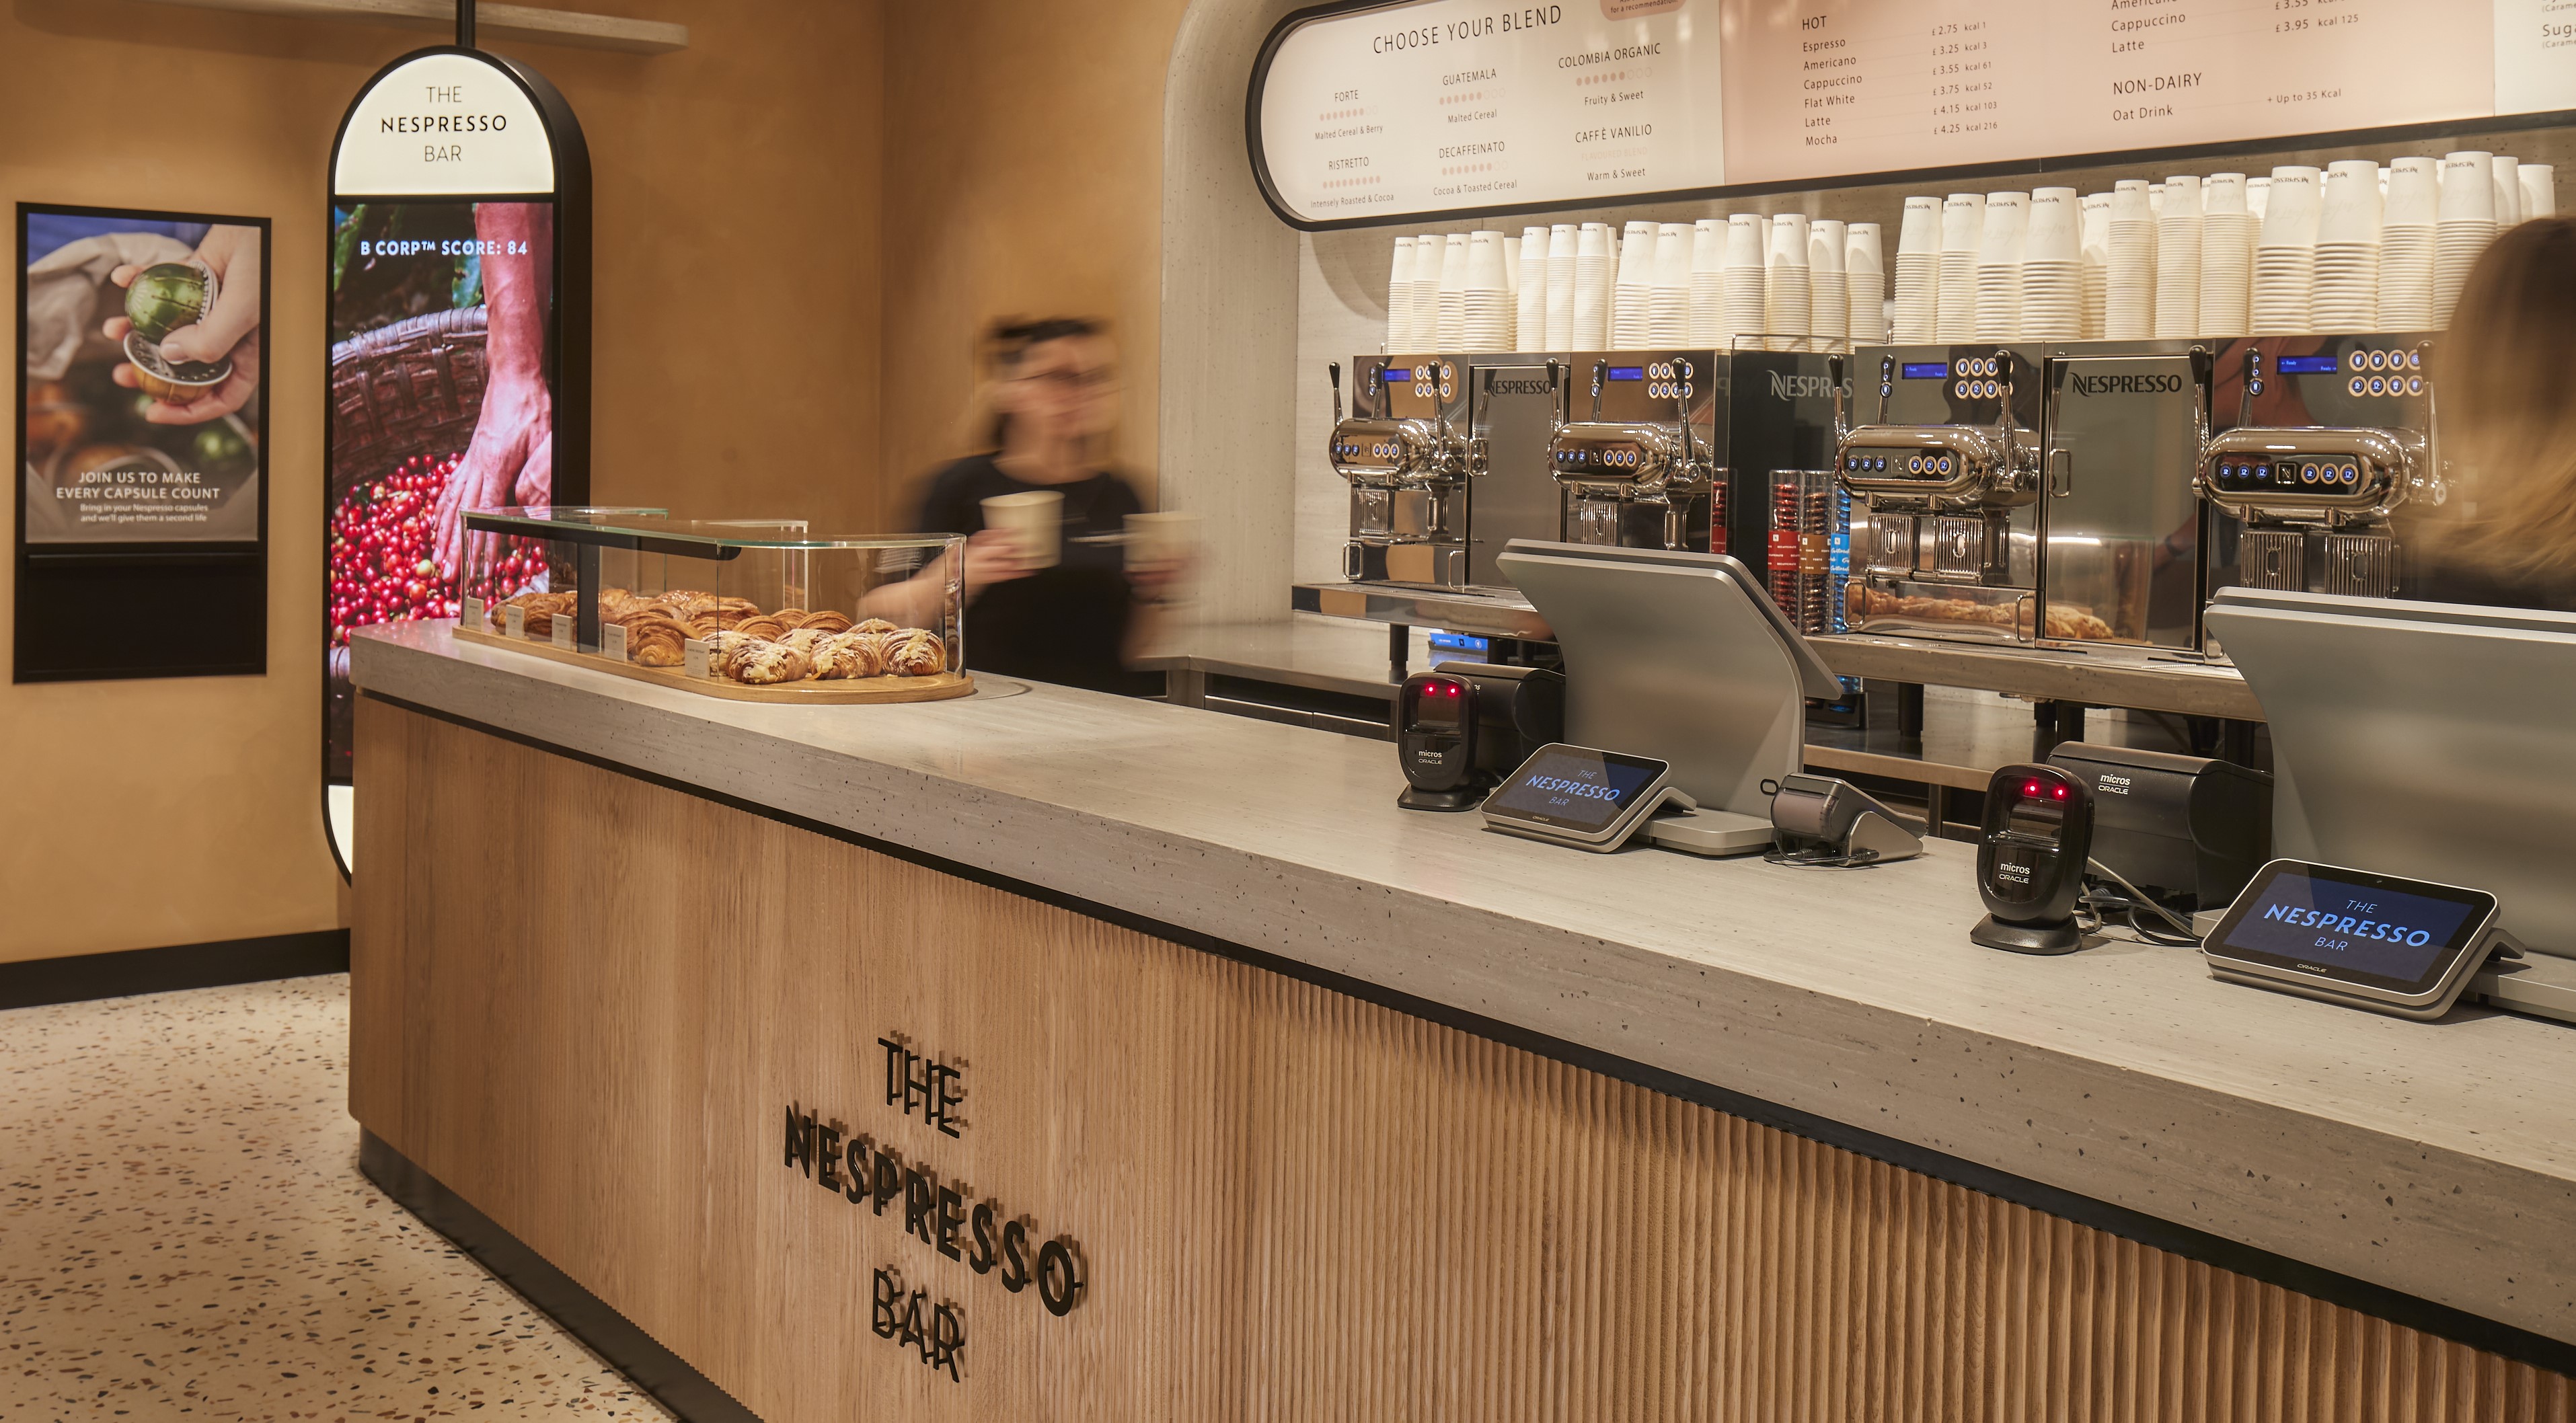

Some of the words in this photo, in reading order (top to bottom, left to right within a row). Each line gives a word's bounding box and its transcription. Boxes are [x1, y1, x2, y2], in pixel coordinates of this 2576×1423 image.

[1373, 26, 1439, 54] CHOOSE
[1447, 17, 1494, 41] YOUR
[1503, 5, 1562, 32] BLEND
[1802, 15, 1827, 31] HOT
[1938, 24, 1958, 36] 2.75
[1964, 23, 1979, 32] kcal
[2112, 13, 2186, 32] Cappuccino
[2284, 19, 2308, 32] 3.95
[2318, 16, 2337, 27] kcal
[2342, 14, 2359, 24] 125
[2542, 24, 2576, 38] Sug
[1803, 38, 1846, 53] Espresso
[1940, 44, 1959, 55] 3.25
[1965, 42, 1980, 52] kcal
[2112, 40, 2145, 53] Latte
[1558, 51, 1610, 69] COLOMBIA
[1614, 43, 1661, 61] ORGANIC
[1804, 56, 1856, 71] Americano
[1940, 64, 1959, 75] 3.55
[1965, 63, 1981, 72] kcal
[1983, 62, 1992, 70] 61
[1443, 69, 1497, 85] GUATEMALA
[1804, 75, 1862, 91] Cappuccino
[2114, 73, 2202, 95] NON-DAIRY
[425, 86, 462, 103] THE
[1334, 90, 1359, 102] FORTE
[1940, 85, 1959, 95] 3.75
[1965, 83, 1981, 92] kcal
[1984, 82, 1993, 91] 52
[1585, 95, 1608, 106] Fruity
[1610, 93, 1616, 102] &
[1619, 91, 1644, 102] Sweet
[1805, 98, 1823, 109] Flat
[1826, 95, 1855, 106] White
[2277, 95, 2289, 104] Up
[2294, 93, 2302, 102] to
[2306, 91, 2318, 100] 35
[2322, 89, 2341, 99] Kcal
[1940, 104, 1960, 115] 4.15
[1966, 102, 1981, 112] kcal
[1984, 102, 1997, 110] 103
[2113, 110, 2134, 121] Oat
[2139, 105, 2173, 119] Drink
[1447, 112, 1472, 124] Malted
[1474, 109, 1497, 120] Cereal
[1805, 116, 1831, 128] Latte
[381, 116, 506, 133] NESPRESSO
[1941, 124, 1961, 134] 4.25
[1967, 123, 1982, 132] kcal
[1984, 122, 1998, 130] 216
[1315, 130, 1336, 141] Malted
[1338, 128, 1358, 138] Cereal
[1360, 126, 1365, 134] &
[1367, 124, 1384, 135] Berry
[1575, 127, 1607, 143] CAFFÈ
[1610, 124, 1653, 140] VANILIO
[1806, 134, 1838, 146] Mocha
[424, 145, 461, 162] BAR
[1439, 141, 1505, 159] DECAFFEINATO
[1582, 148, 1622, 162] FLAVOURED
[1624, 147, 1648, 157] BLEND
[1329, 157, 1369, 170] RISTRETTO
[1587, 171, 1610, 182] Warm
[1613, 169, 1618, 179] &
[1620, 168, 1646, 179] Sweet
[1433, 186, 1455, 196] Cocoa
[1457, 186, 1462, 194] &
[1464, 182, 1492, 193] Toasted
[1494, 180, 1517, 190] Cereal
[1311, 198, 1339, 209] Intensely
[1341, 196, 1366, 206] Roasted
[1367, 195, 1372, 203] &
[1374, 194, 1394, 202] Cocoa
[361, 242, 371, 255] B
[441, 241, 501, 255] SCORE:
[507, 241, 527, 255] 84
[2069, 372, 2182, 397] NESPRESSO
[78, 472, 112, 484] JOIN
[117, 472, 135, 484] US
[140, 472, 158, 484] TO
[162, 472, 201, 484] MAKE
[56, 488, 100, 499] EVERY
[104, 488, 167, 499] CAPSULE
[172, 488, 221, 499] COUNT
[80, 504, 102, 514] Bring
[104, 504, 112, 512] in
[113, 506, 132, 514] your
[133, 504, 174, 514] Nespresso
[175, 504, 209, 514] capsules
[81, 514, 97, 523] and
[98, 514, 117, 523] we'll
[118, 514, 135, 524] give
[136, 514, 157, 523] them
[165, 514, 194, 523] second
[194, 514, 207, 523] life
[1418, 750, 1443, 758] micros
[1577, 769, 1597, 780] THE
[2100, 774, 2131, 786] micros
[1525, 775, 1621, 802] NESPRESSO
[2098, 785, 2129, 796] ORACLE
[1549, 796, 1570, 806] BAR
[2000, 862, 2031, 875] micros
[1999, 874, 2029, 884] ORACLE
[2346, 900, 2378, 914] THE
[2264, 904, 2431, 948] NESPRESSO
[2314, 936, 2349, 952] BAR
[2297, 964, 2328, 974] ORACLE
[878, 1037, 960, 1139] THE
[784, 1105, 1075, 1317] NESPRESSO
[872, 1267, 960, 1383] BAR
